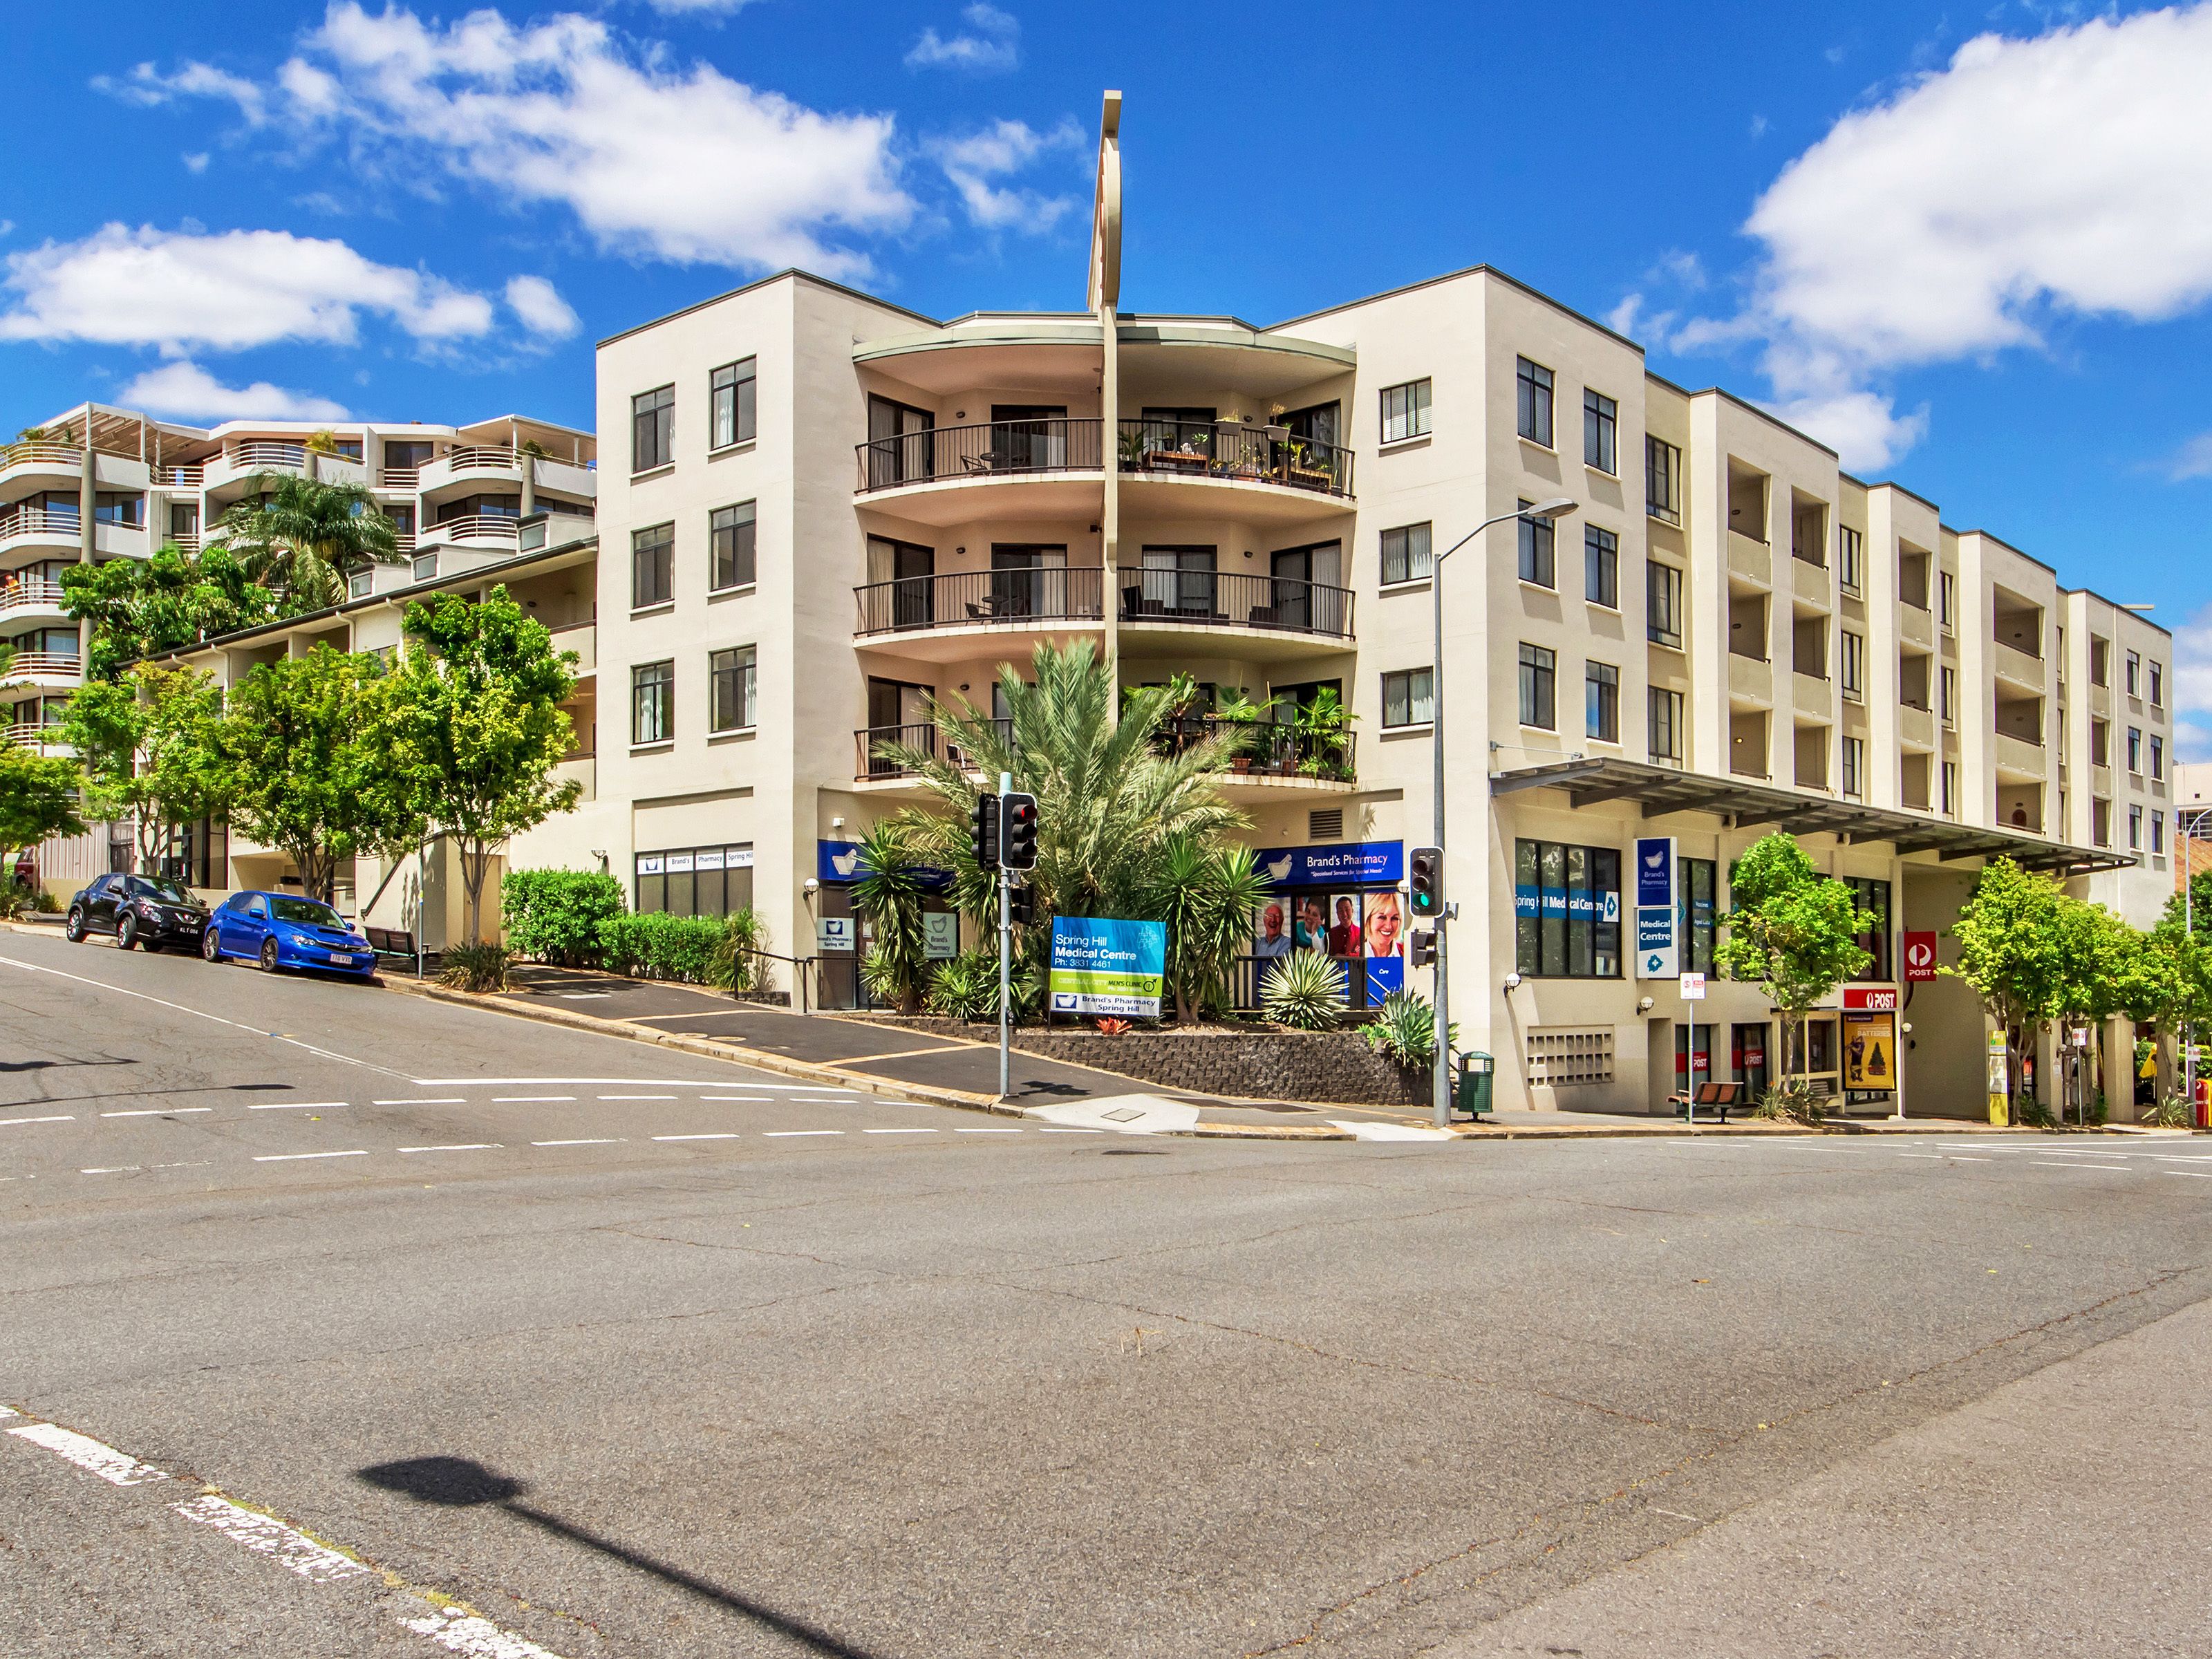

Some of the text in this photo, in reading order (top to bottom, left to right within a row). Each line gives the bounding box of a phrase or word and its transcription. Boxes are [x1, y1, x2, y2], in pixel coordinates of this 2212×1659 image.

[1307, 854, 1388, 867] Brand's Pharmacy
[1549, 896, 1580, 910] Medcal
[1580, 898, 1604, 911] Cenre
[1056, 934, 1107, 948] Spring Hill
[1640, 932, 1671, 941] Centre
[1056, 946, 1137, 961] Medical Centre
[1054, 958, 1068, 966] Ph:
[1070, 959, 1089, 967] 3831
[1082, 995, 1156, 1006] Brand's Pharmacy
[1875, 993, 1895, 1008] POST
[1098, 1004, 1124, 1013] Spring
[1694, 1058, 1707, 1067] POST
[1749, 1056, 1763, 1065] POST
